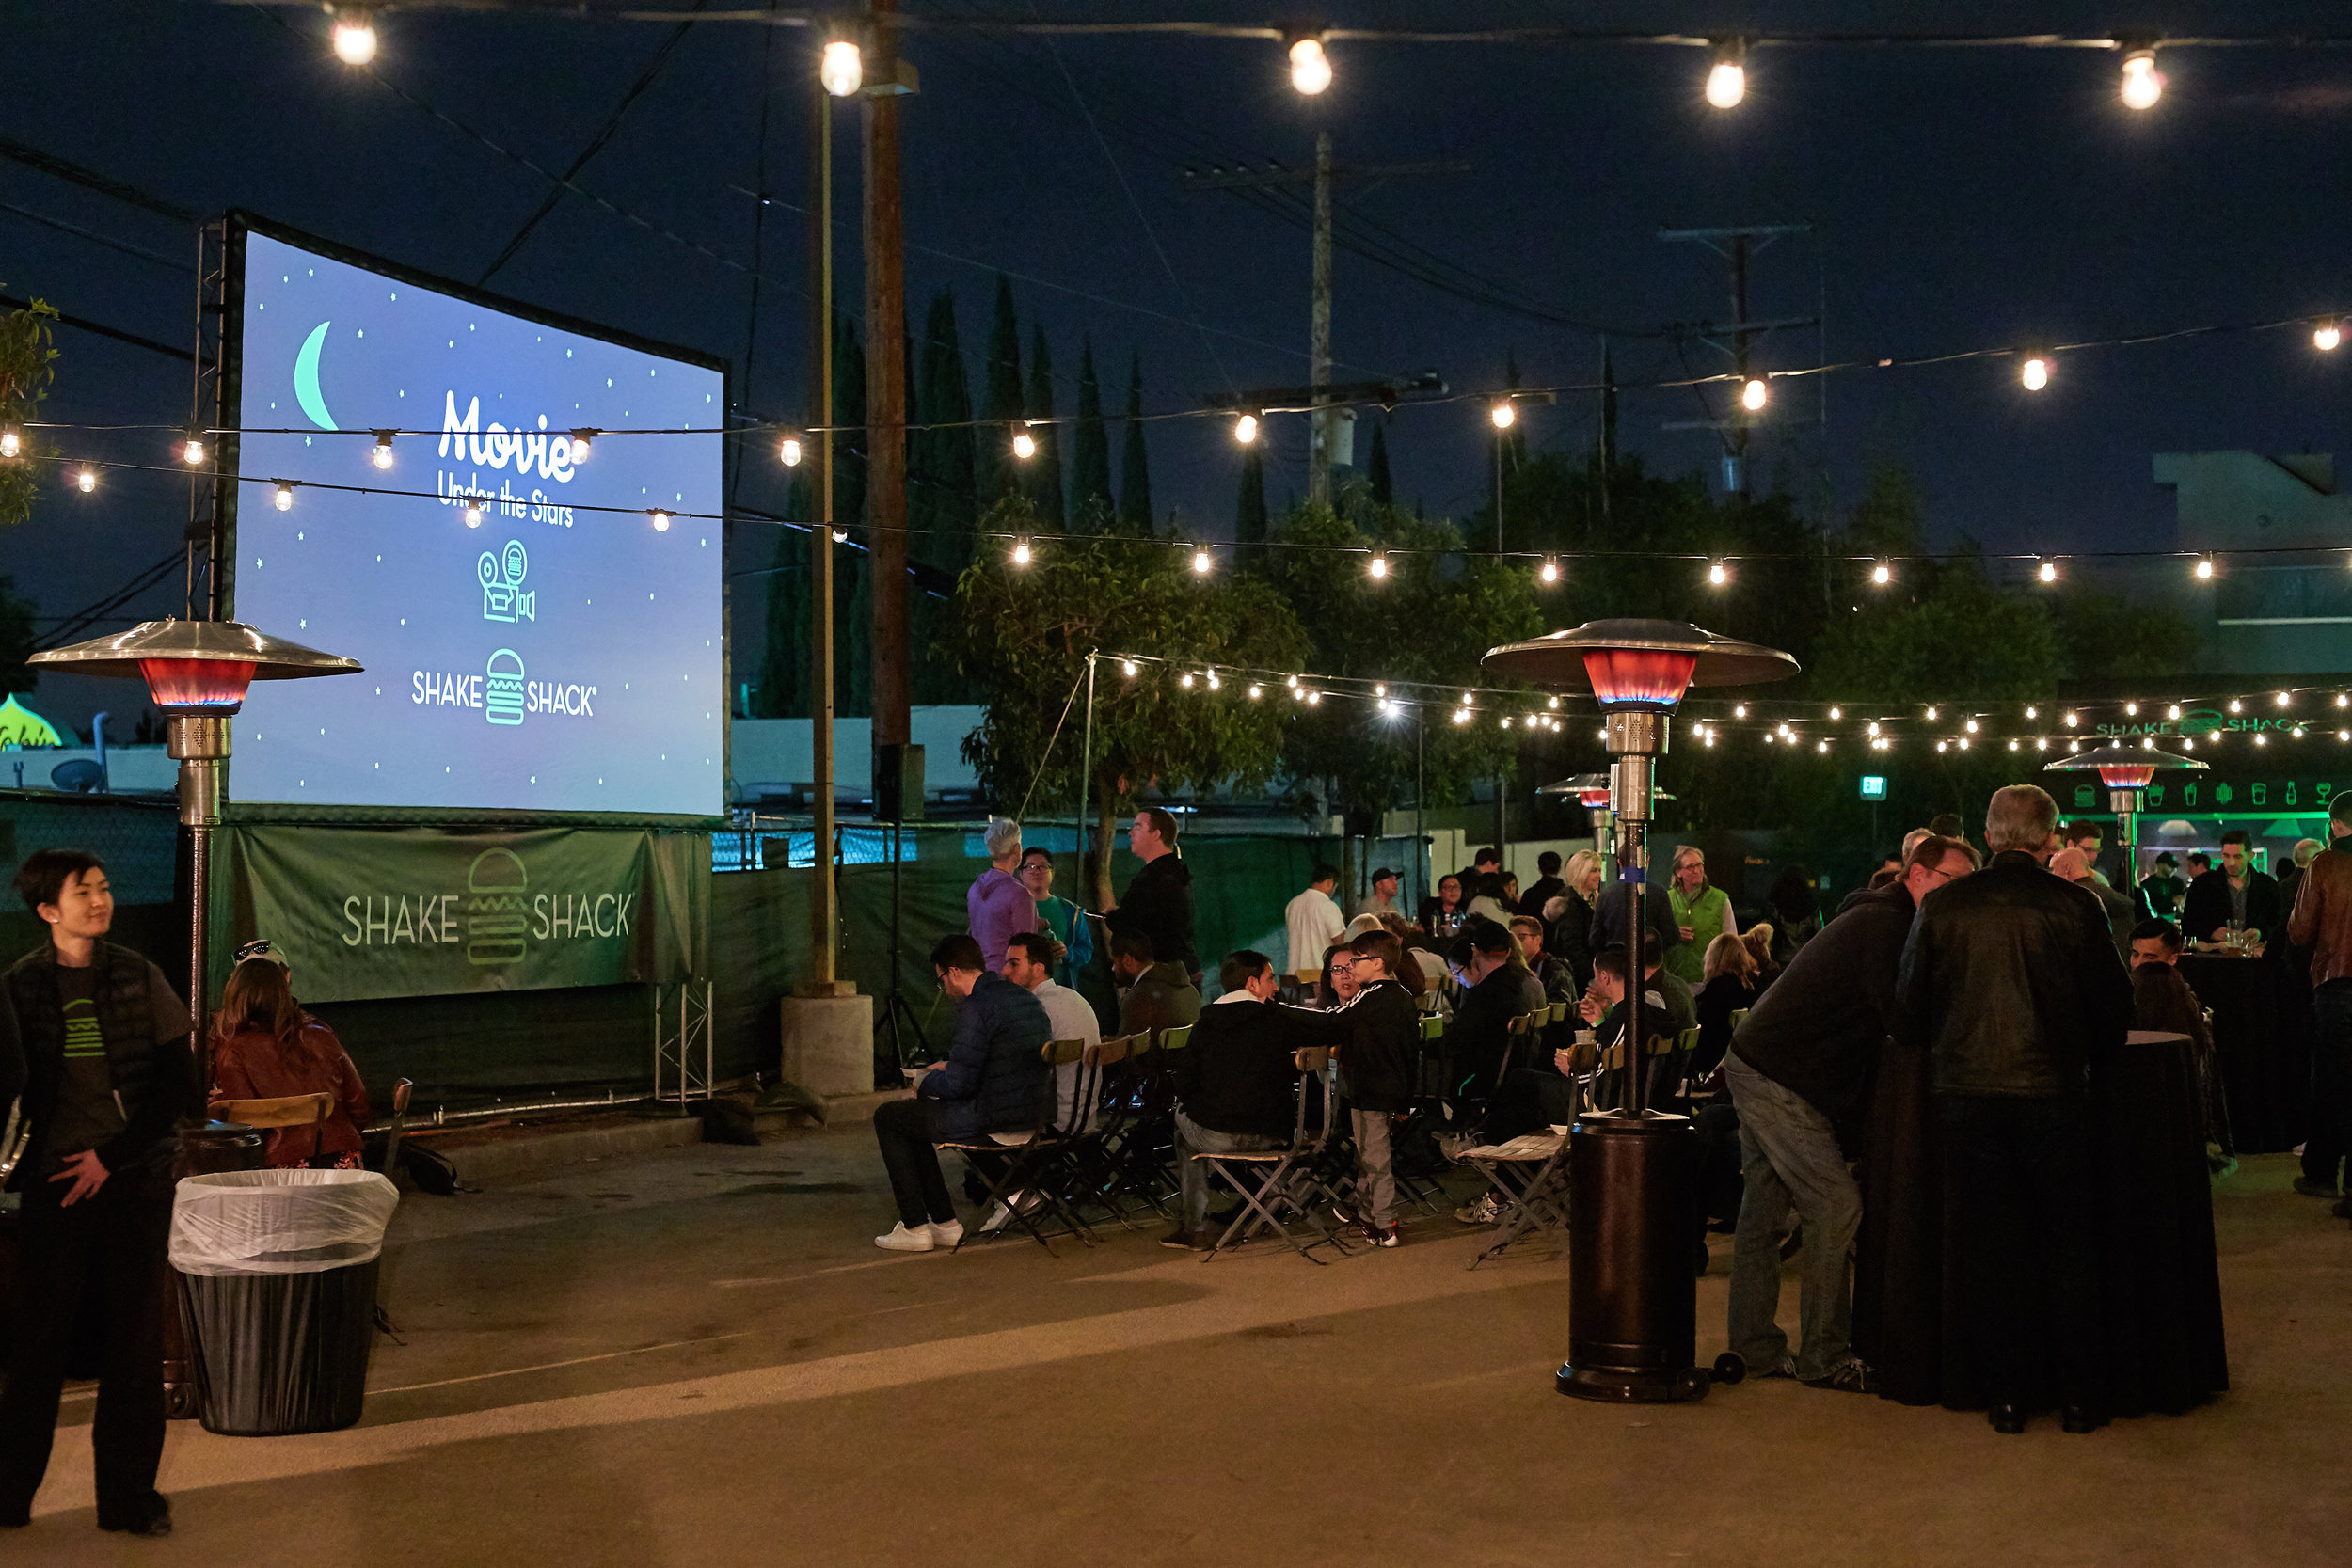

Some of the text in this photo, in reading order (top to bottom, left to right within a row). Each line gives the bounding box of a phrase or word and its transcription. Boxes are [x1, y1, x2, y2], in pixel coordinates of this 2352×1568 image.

[438, 390, 575, 483] Movie
[437, 470, 574, 528] Under the Stars
[412, 671, 594, 717] SHAKE SHACK
[2096, 721, 2173, 736] SHAKE
[342, 893, 633, 946] SHAKE SHACK
